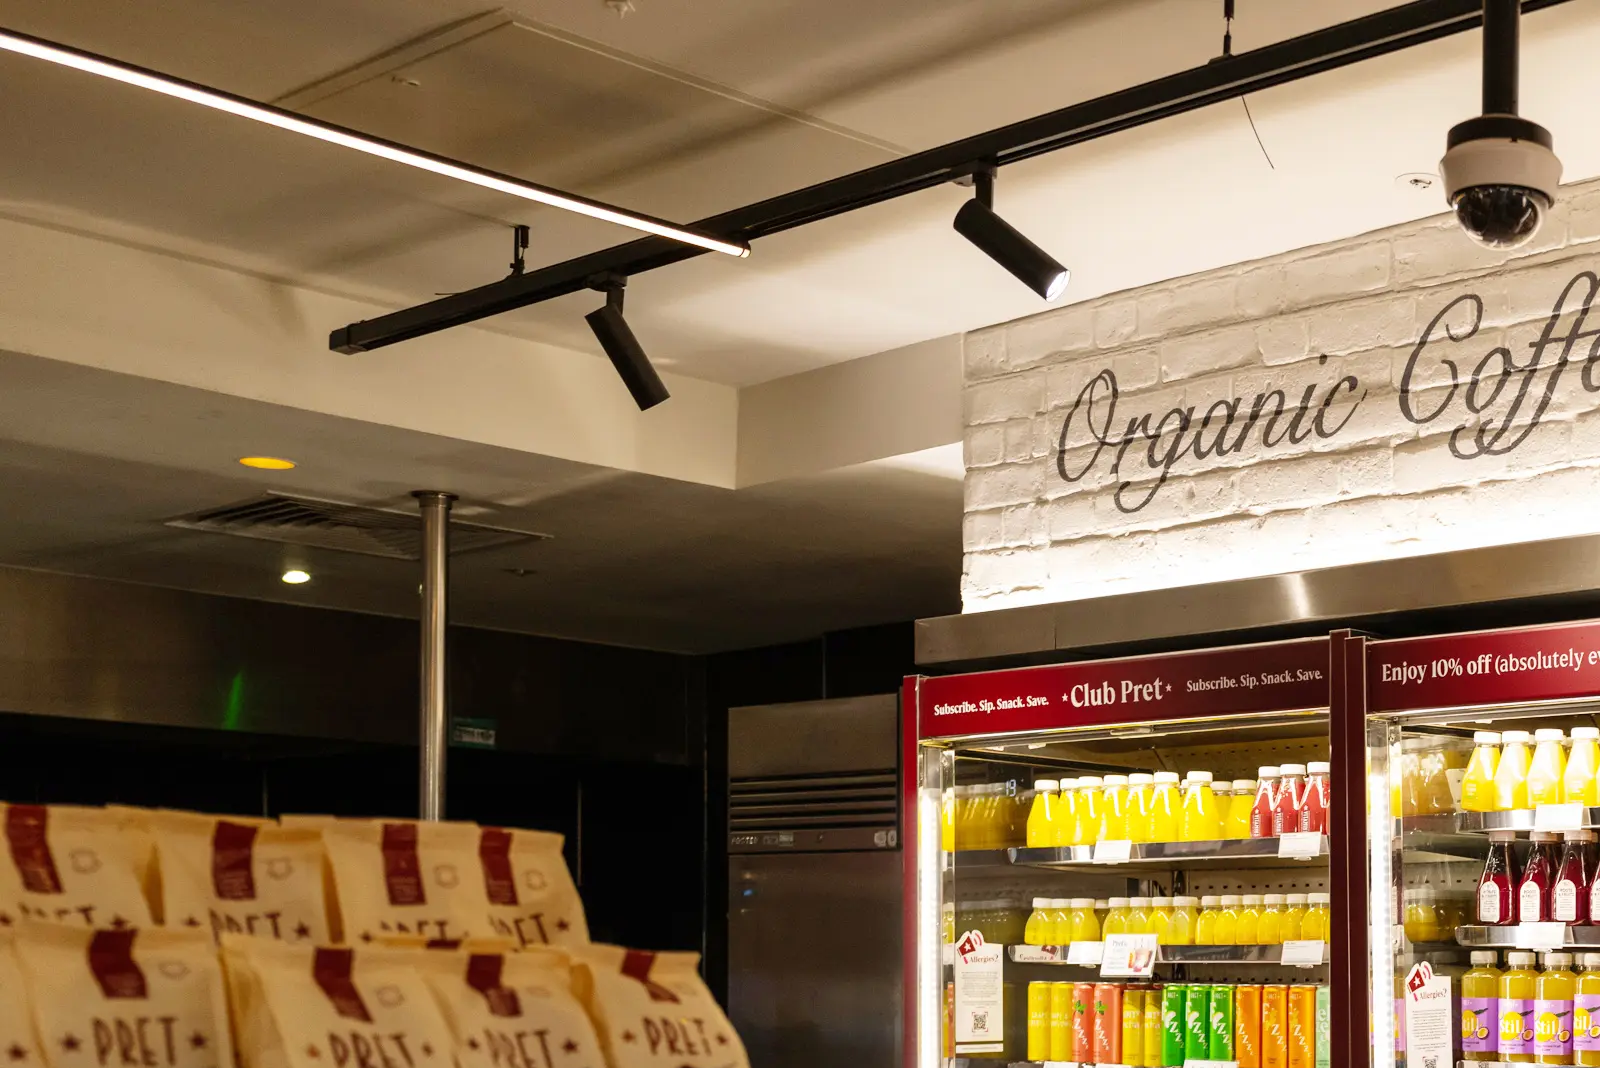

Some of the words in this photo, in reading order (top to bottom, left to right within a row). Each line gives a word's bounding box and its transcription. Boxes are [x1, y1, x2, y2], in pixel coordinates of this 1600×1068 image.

[1056, 354, 1366, 513] Organic
[1186, 675, 1238, 692] Subscribe.
[1240, 673, 1259, 688] Sip.
[1261, 671, 1295, 685] Snack.
[1297, 669, 1323, 682] Save.
[1382, 662, 1426, 684] Enjoy
[1430, 658, 1463, 678] 10%
[1466, 653, 1491, 675] off
[1495, 648, 1584, 675] (absolutely
[934, 701, 977, 716] Subscribe.
[979, 700, 995, 713] Sip.
[997, 697, 1025, 709] Snack.
[1027, 695, 1049, 706] Save.
[1071, 683, 1116, 708] Club
[1120, 677, 1163, 703] Pret
[969, 954, 998, 965] Allergies?
[1419, 988, 1447, 1000] Allergies?
[93, 1017, 180, 1067] PRET
[642, 1016, 711, 1057] PRET
